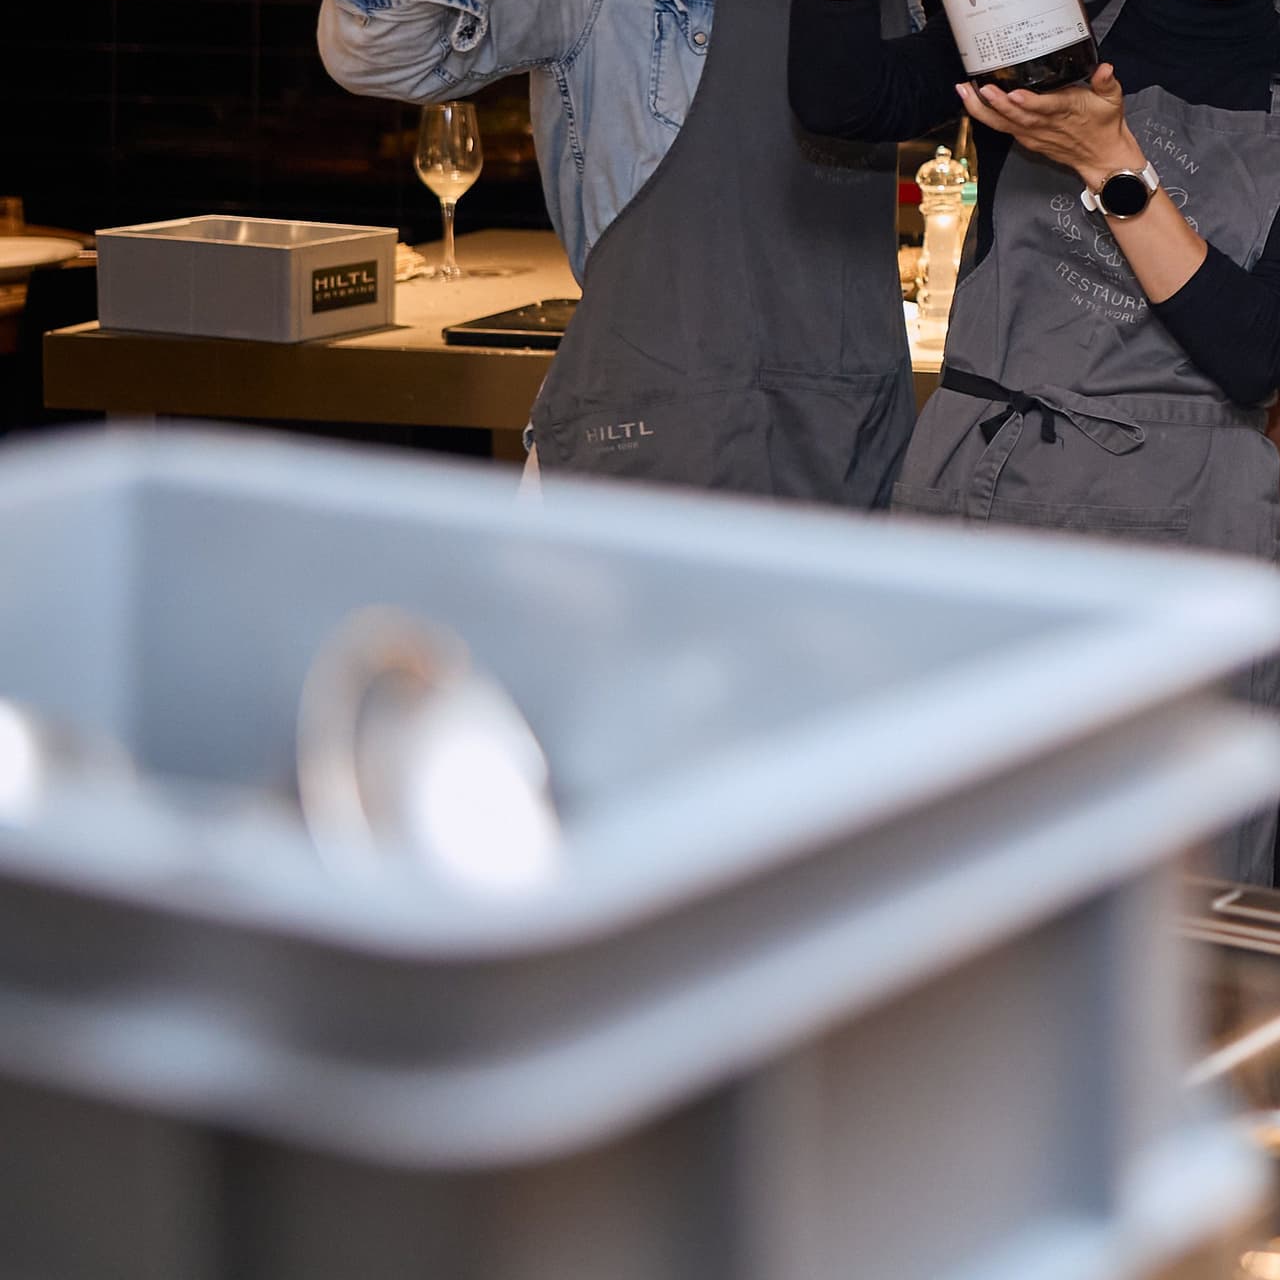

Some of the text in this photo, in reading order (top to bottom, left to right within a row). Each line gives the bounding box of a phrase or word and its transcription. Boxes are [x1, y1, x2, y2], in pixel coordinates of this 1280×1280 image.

[1143, 129, 1200, 175] TARIAN
[314, 270, 375, 292] HILTL
[1055, 261, 1147, 311] RESTAURA
[1104, 308, 1137, 324] WORL
[585, 421, 655, 443] HILTL
